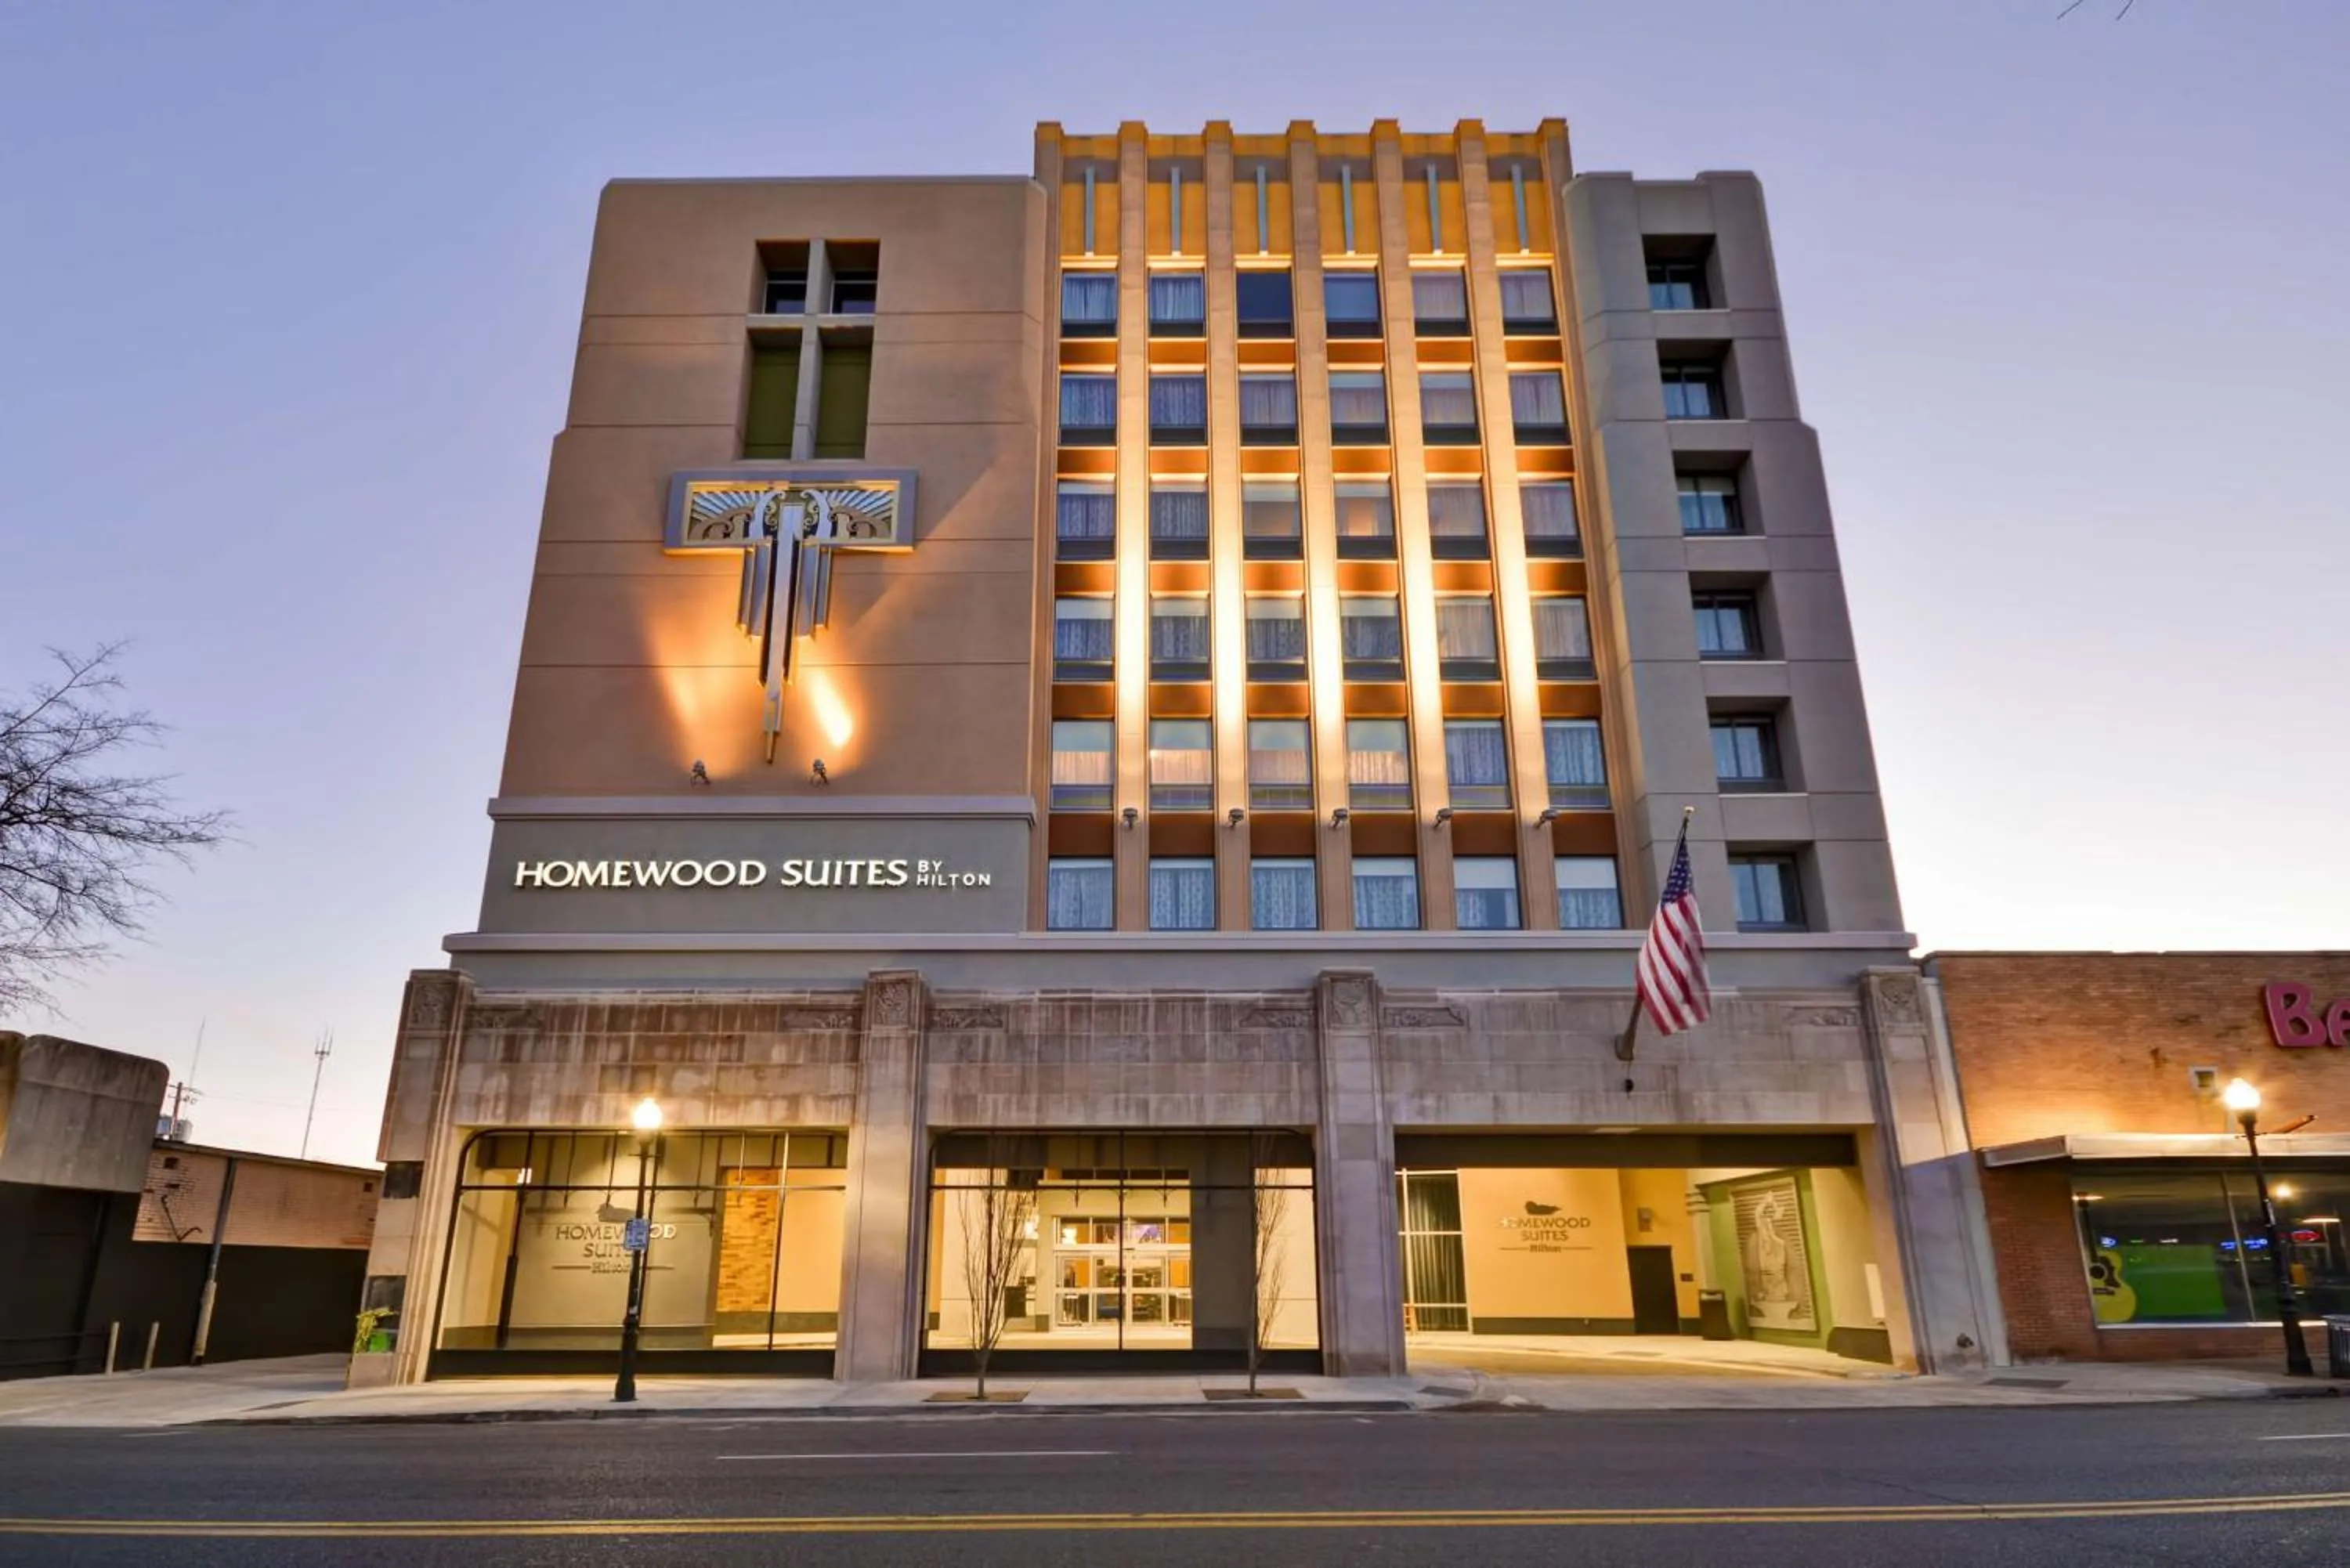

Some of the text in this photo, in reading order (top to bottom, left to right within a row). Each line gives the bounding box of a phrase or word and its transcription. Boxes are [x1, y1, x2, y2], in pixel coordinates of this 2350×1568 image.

[514, 859, 909, 887] HOMEWOOD SUITES
[917, 859, 942, 873] BY
[916, 873, 991, 887] HILTON
[555, 1223, 677, 1240] HOMEWOD
[1521, 1230, 1569, 1241] SUITES
